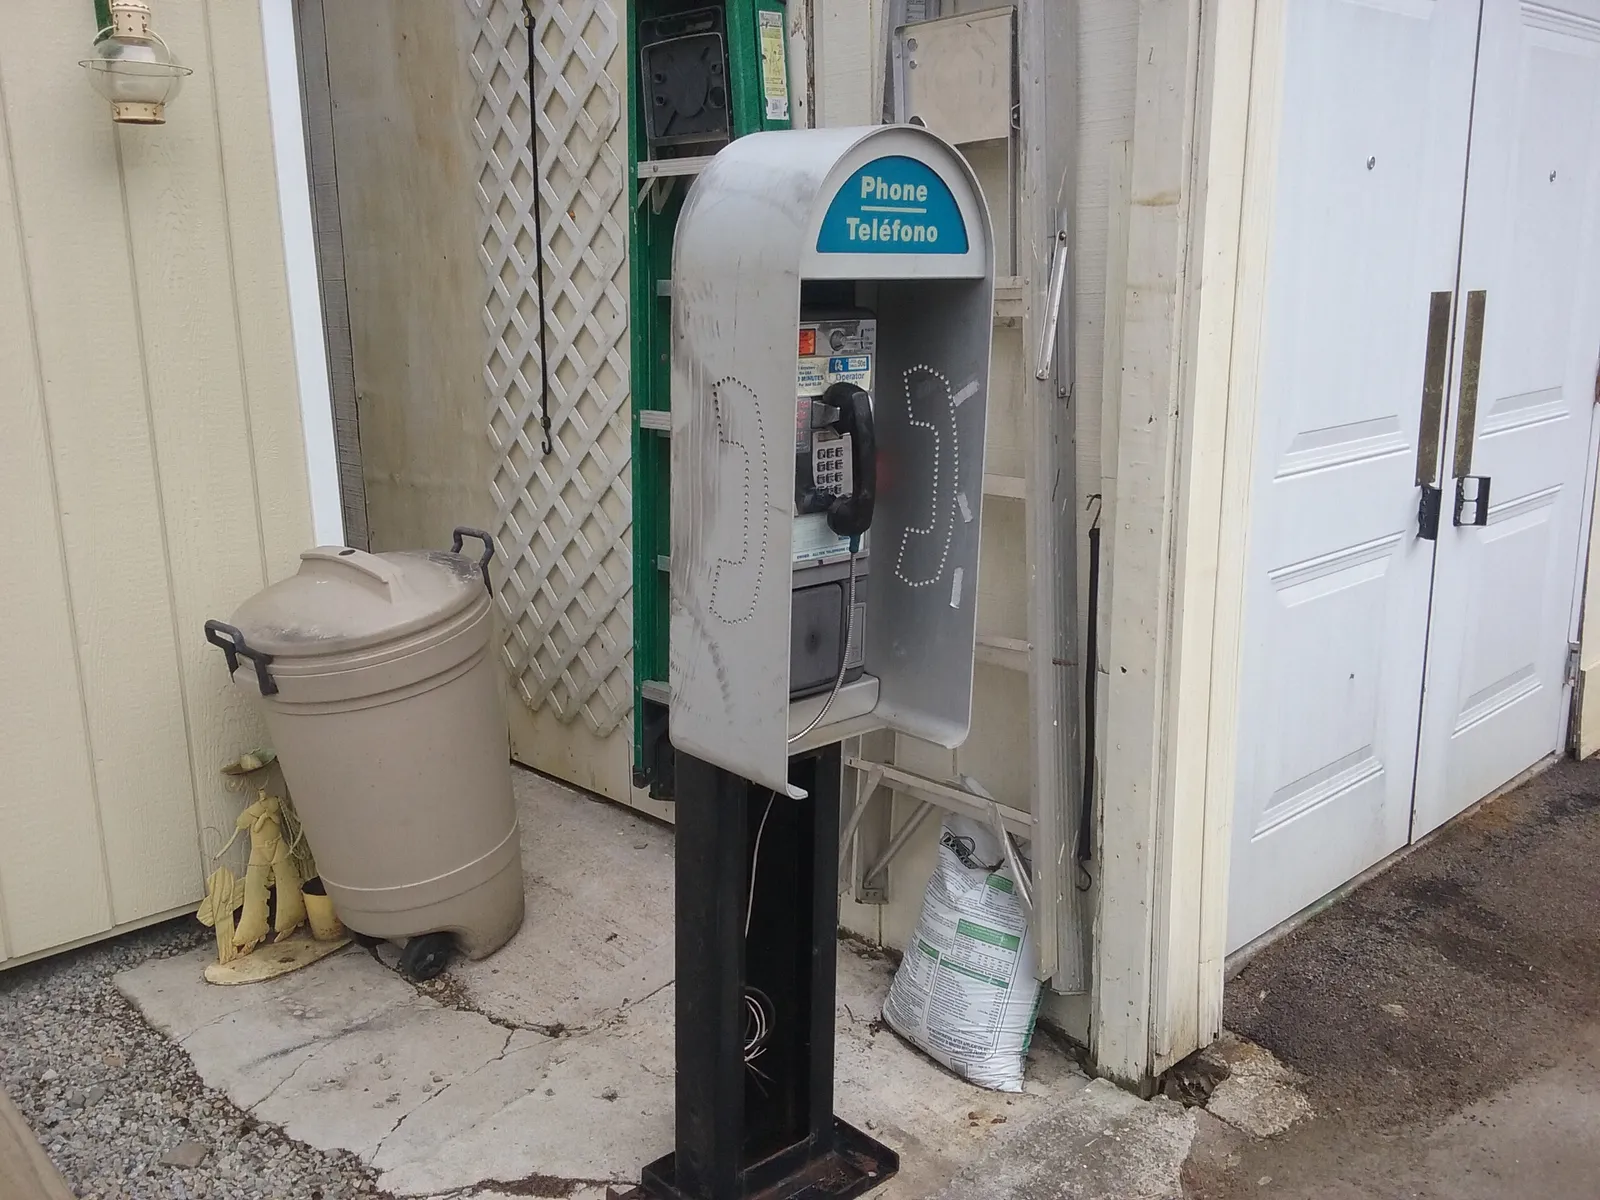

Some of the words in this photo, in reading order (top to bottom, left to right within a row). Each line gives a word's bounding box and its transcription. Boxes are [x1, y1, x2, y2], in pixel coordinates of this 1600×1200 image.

[861, 175, 928, 202] Phone
[846, 217, 938, 243] Teléfono
[836, 373, 864, 381] Operator
